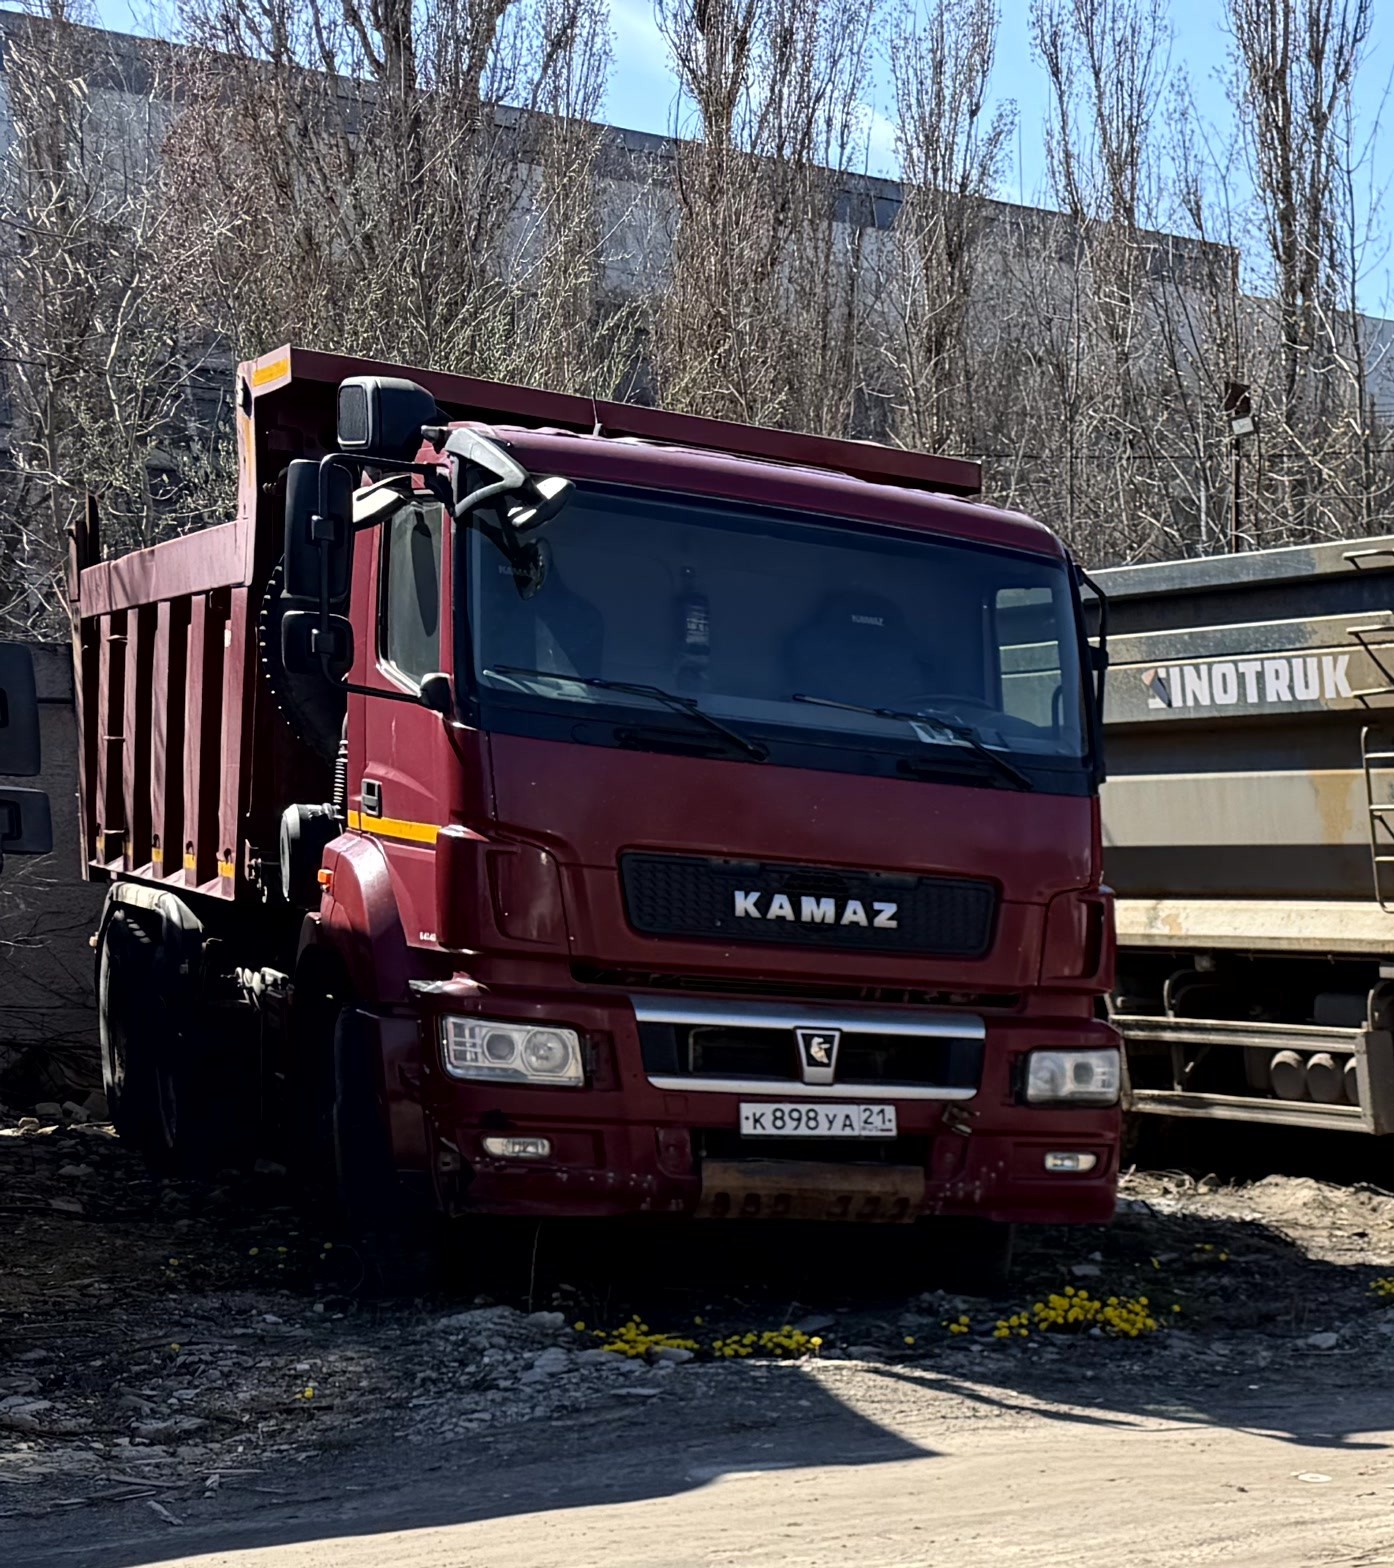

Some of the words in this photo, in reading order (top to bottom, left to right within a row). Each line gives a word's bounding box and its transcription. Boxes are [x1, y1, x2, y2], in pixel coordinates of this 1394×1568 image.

[1142, 654, 1355, 709] SINOTRUK
[734, 890, 898, 929] KAMAZ
[862, 1108, 886, 1125] 21
